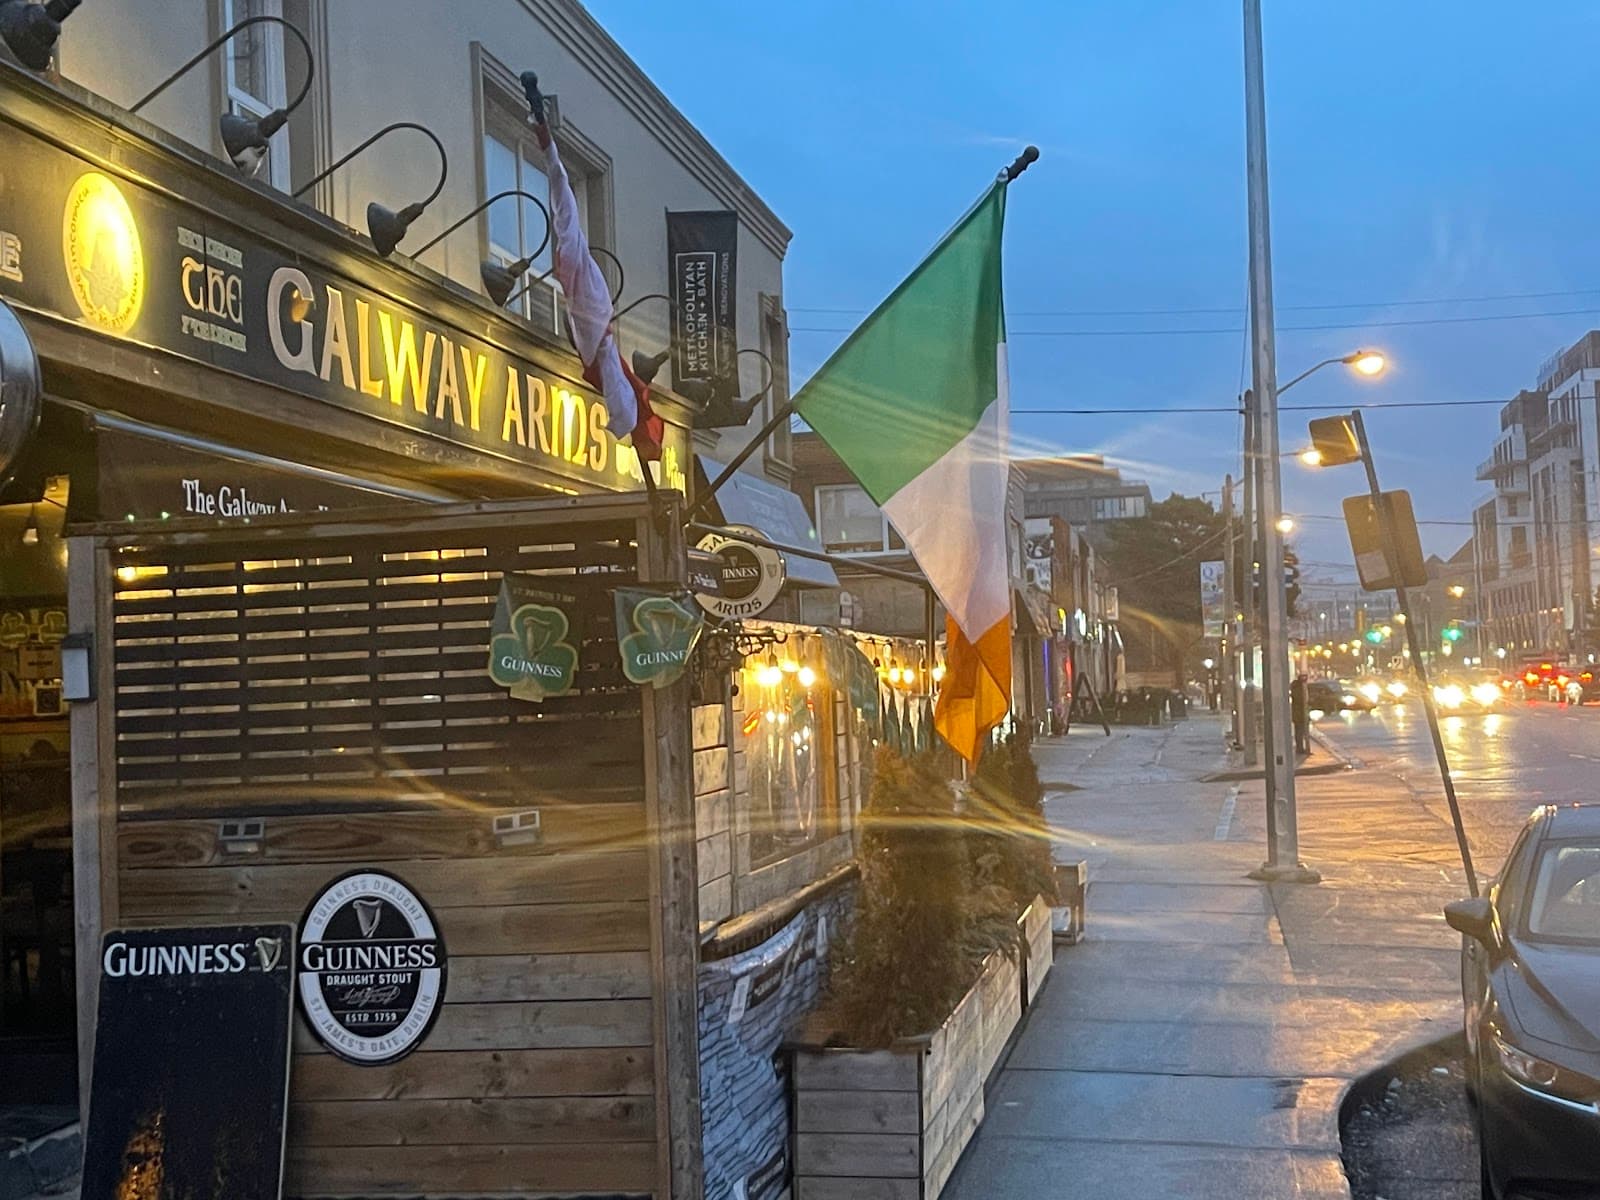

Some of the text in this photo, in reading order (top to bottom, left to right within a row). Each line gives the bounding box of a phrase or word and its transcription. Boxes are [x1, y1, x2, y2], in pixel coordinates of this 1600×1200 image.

[697, 261, 707, 297] BATH
[685, 261, 698, 372] METROPOLITAN
[267, 266, 487, 432] GALWAY
[501, 366, 608, 472] ARMS
[182, 479, 215, 515] The
[501, 655, 563, 678] GUINNESS
[313, 878, 423, 926] GUINNESS DRAUGHT
[104, 942, 246, 977] GUINNESS
[303, 943, 437, 971] GUINNESS
[326, 972, 413, 986] DRAUGHT STOUT
[374, 1011, 398, 1022] 1759
[403, 994, 432, 1036] DUBLIN
